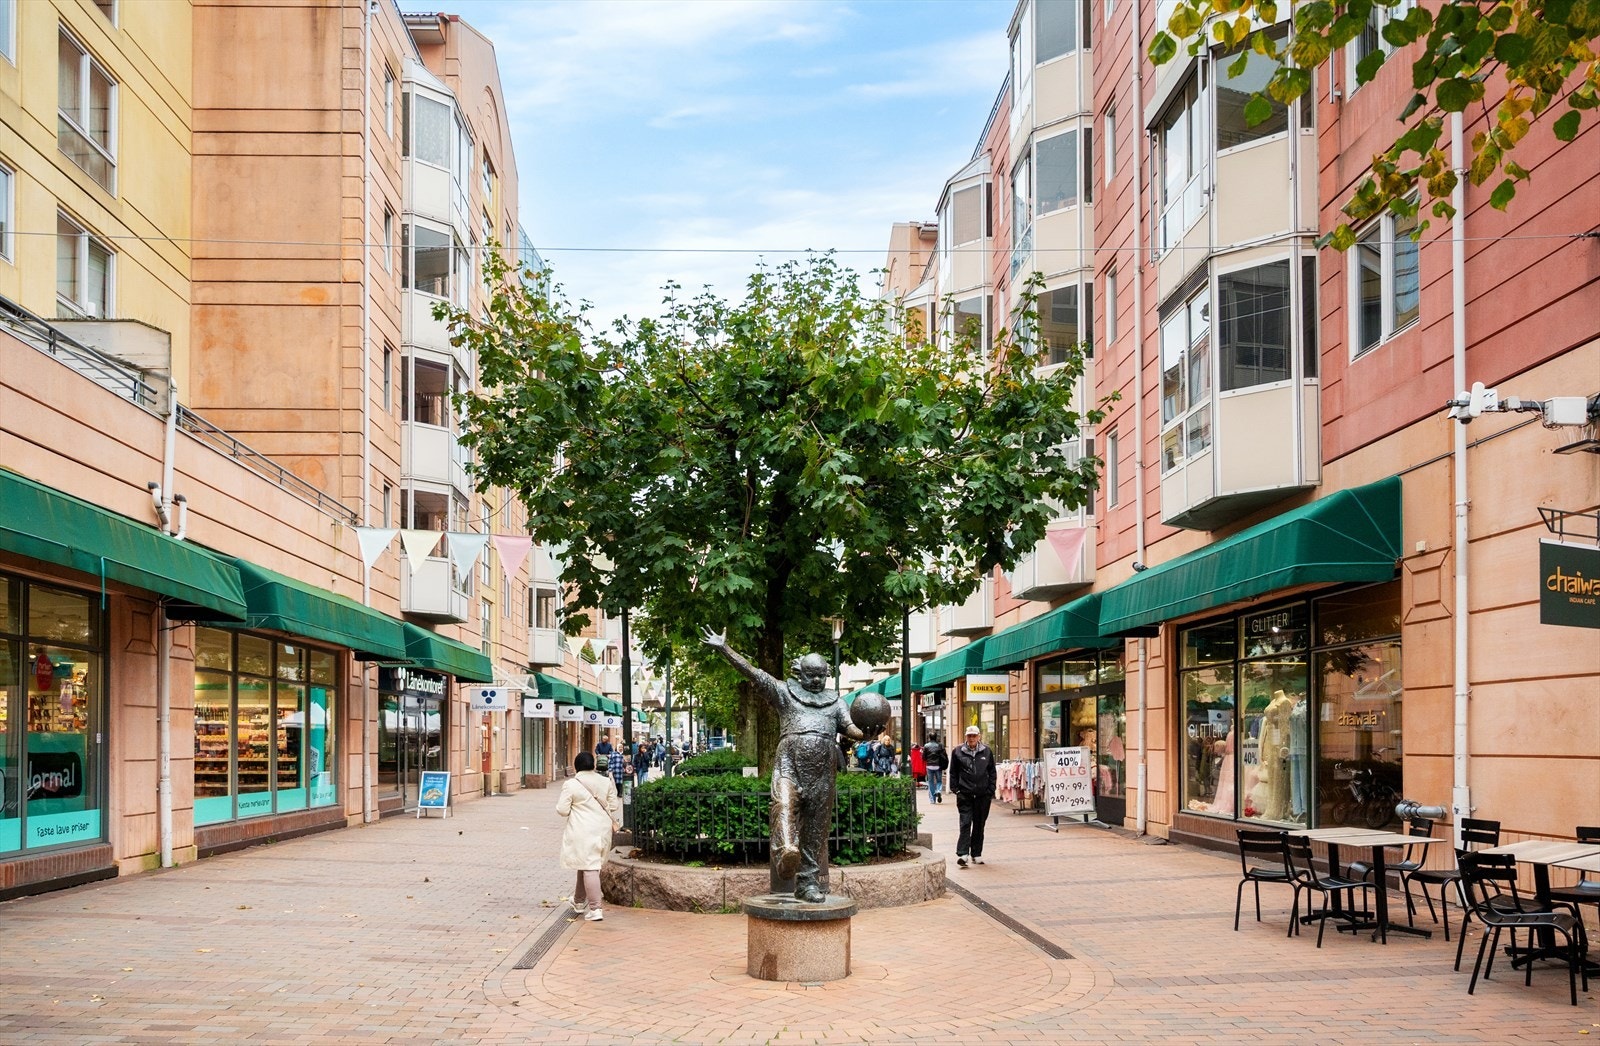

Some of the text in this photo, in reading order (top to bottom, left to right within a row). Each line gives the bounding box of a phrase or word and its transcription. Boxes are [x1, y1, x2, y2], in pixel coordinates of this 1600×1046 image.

[1252, 612, 1288, 632] GLITTER
[406, 671, 443, 694] Lånekontoret
[1338, 709, 1378, 726] chaiwala
[1058, 757, 1079, 766] 40%
[1244, 752, 1257, 765] 40%
[1050, 766, 1087, 777] SALG
[1051, 782, 1087, 792] 199,- 99,-
[1050, 795, 1070, 804] 249,-
[37, 822, 89, 837] Faste lave priser
